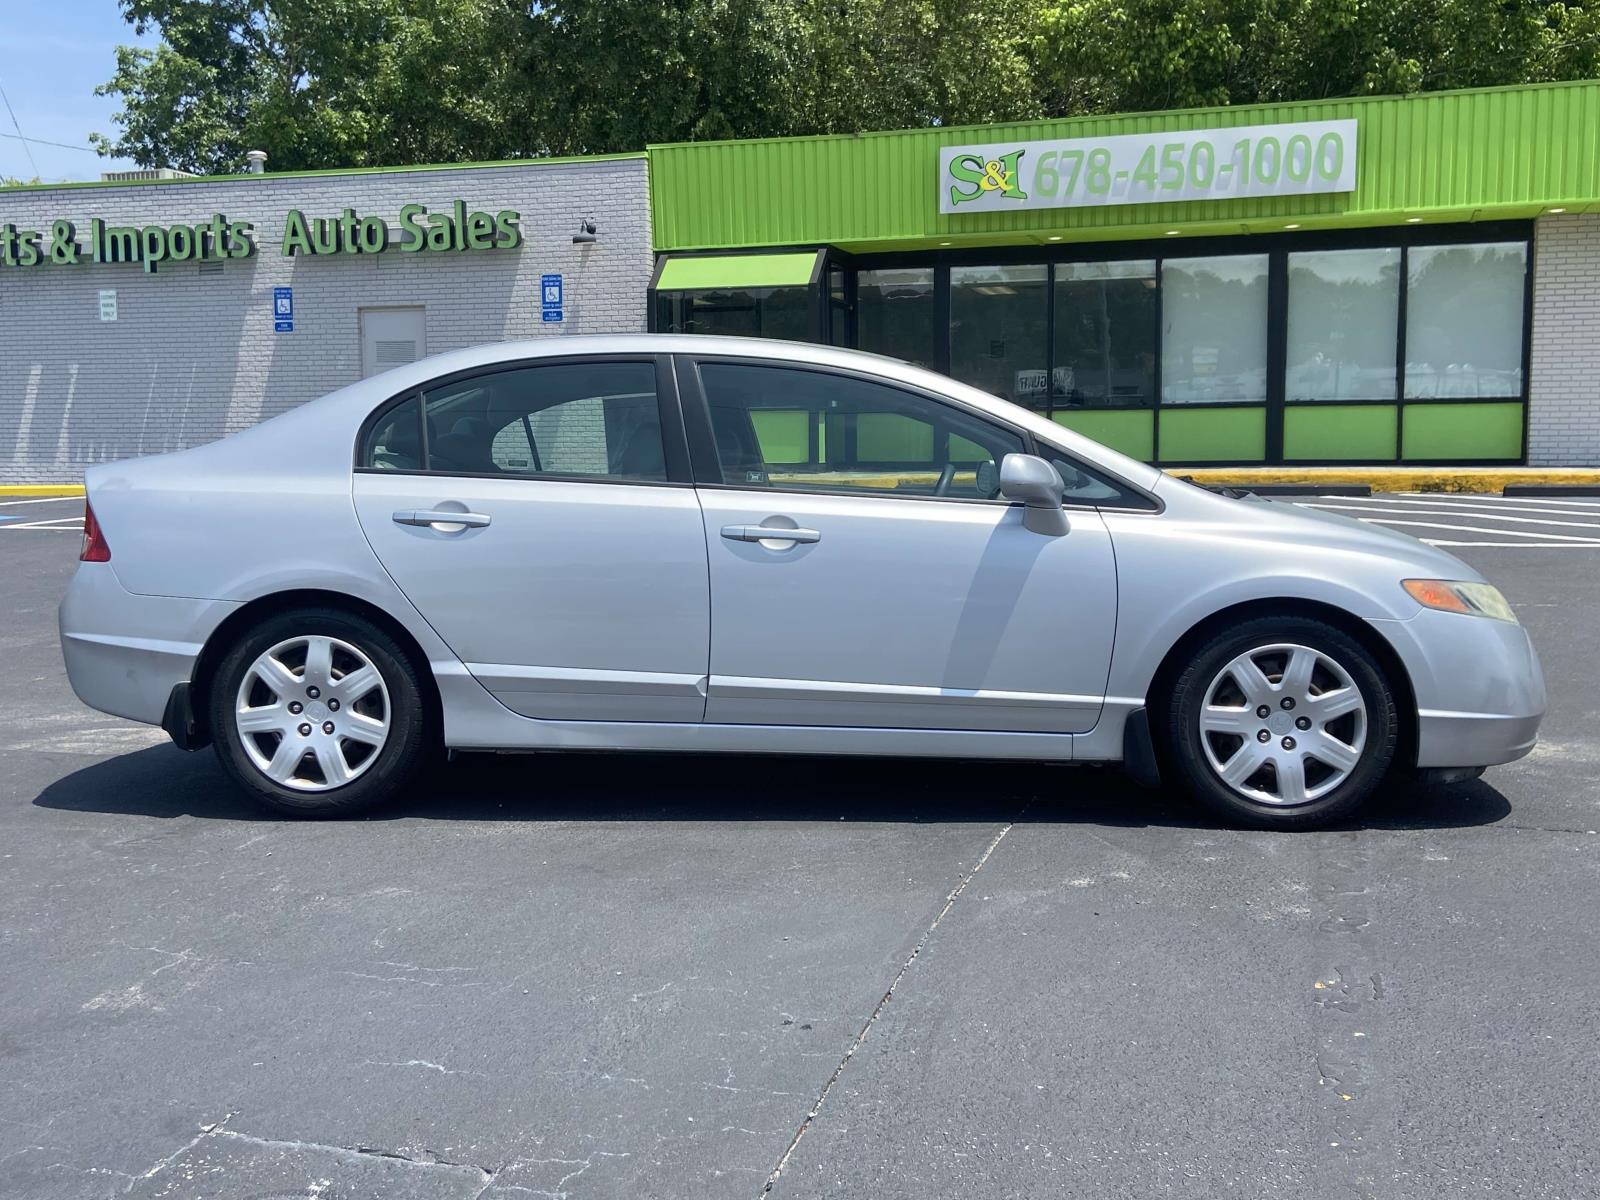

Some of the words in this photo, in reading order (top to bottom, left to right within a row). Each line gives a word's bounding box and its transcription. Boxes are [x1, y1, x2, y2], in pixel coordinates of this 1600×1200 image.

[1035, 132, 1344, 197] 678-450-1000
[51, 219, 77, 265] &
[92, 213, 256, 273] Imports
[282, 207, 384, 256] Auto
[400, 200, 520, 252] Sales
